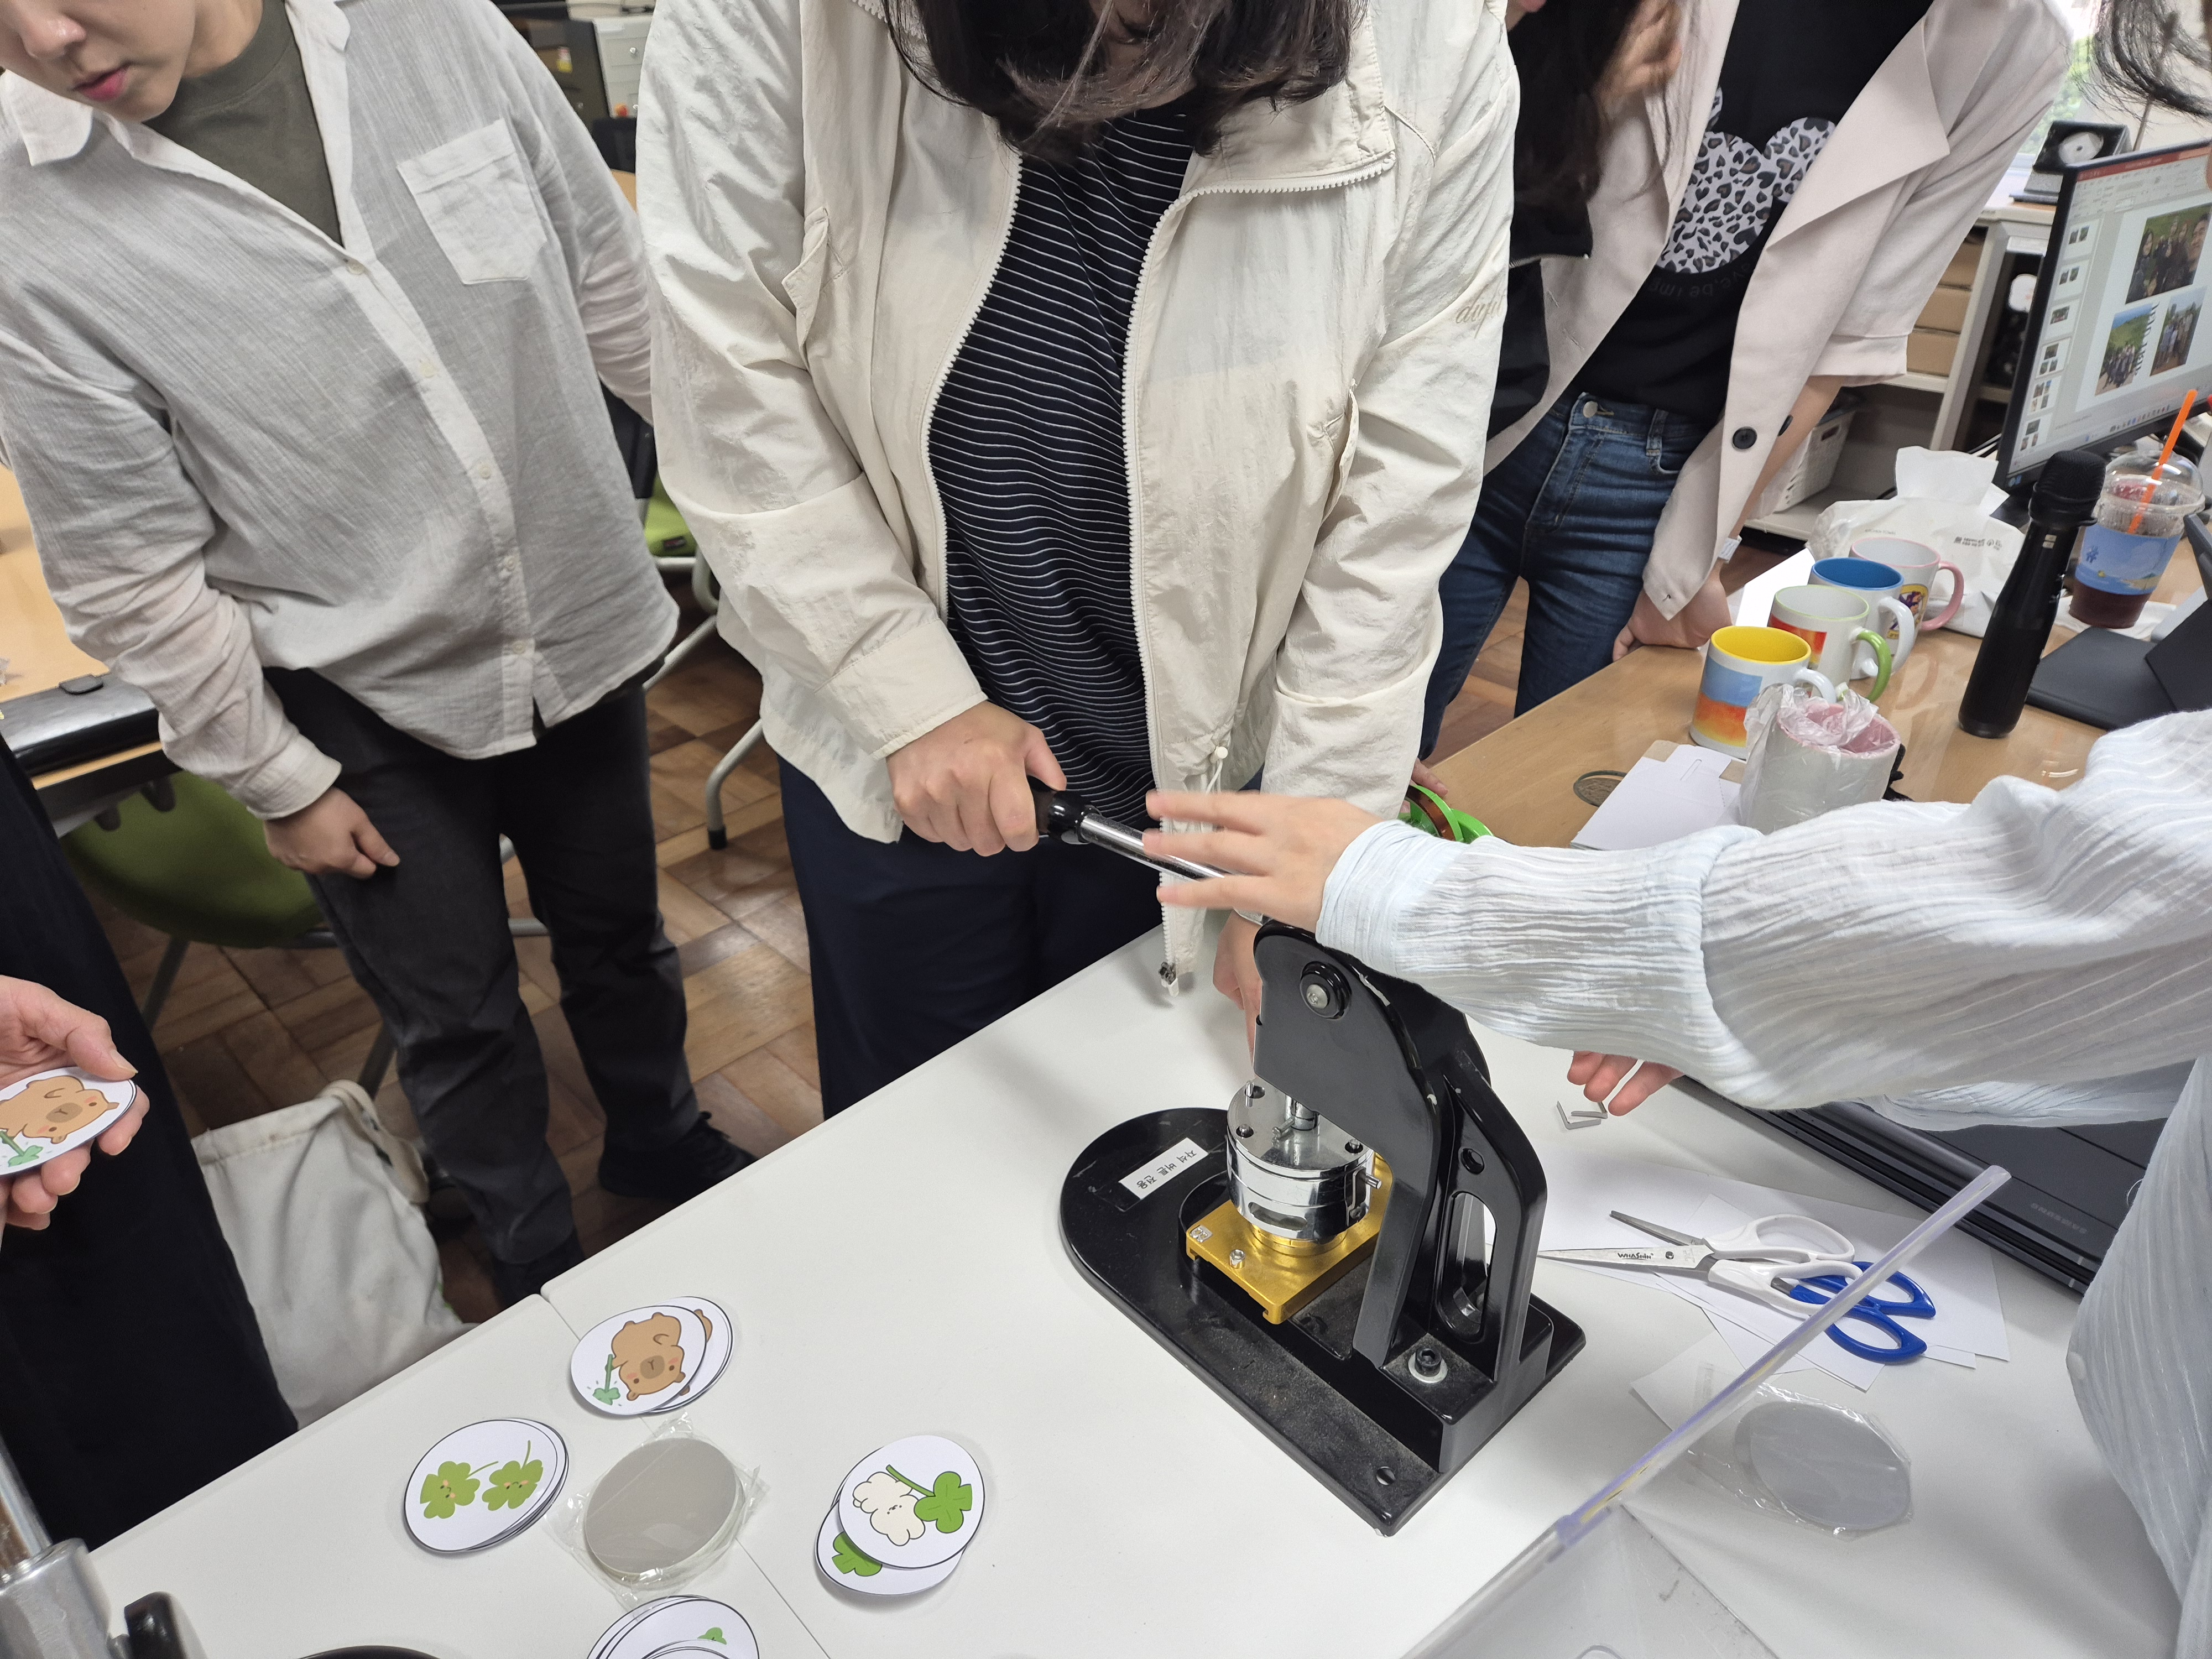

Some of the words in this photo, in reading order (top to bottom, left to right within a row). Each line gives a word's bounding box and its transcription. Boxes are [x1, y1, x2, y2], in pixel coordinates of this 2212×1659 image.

[1176, 1150, 1197, 1163] 자석
[1156, 1163, 1177, 1176] 버튼
[1136, 1175, 1157, 1189] 전용
